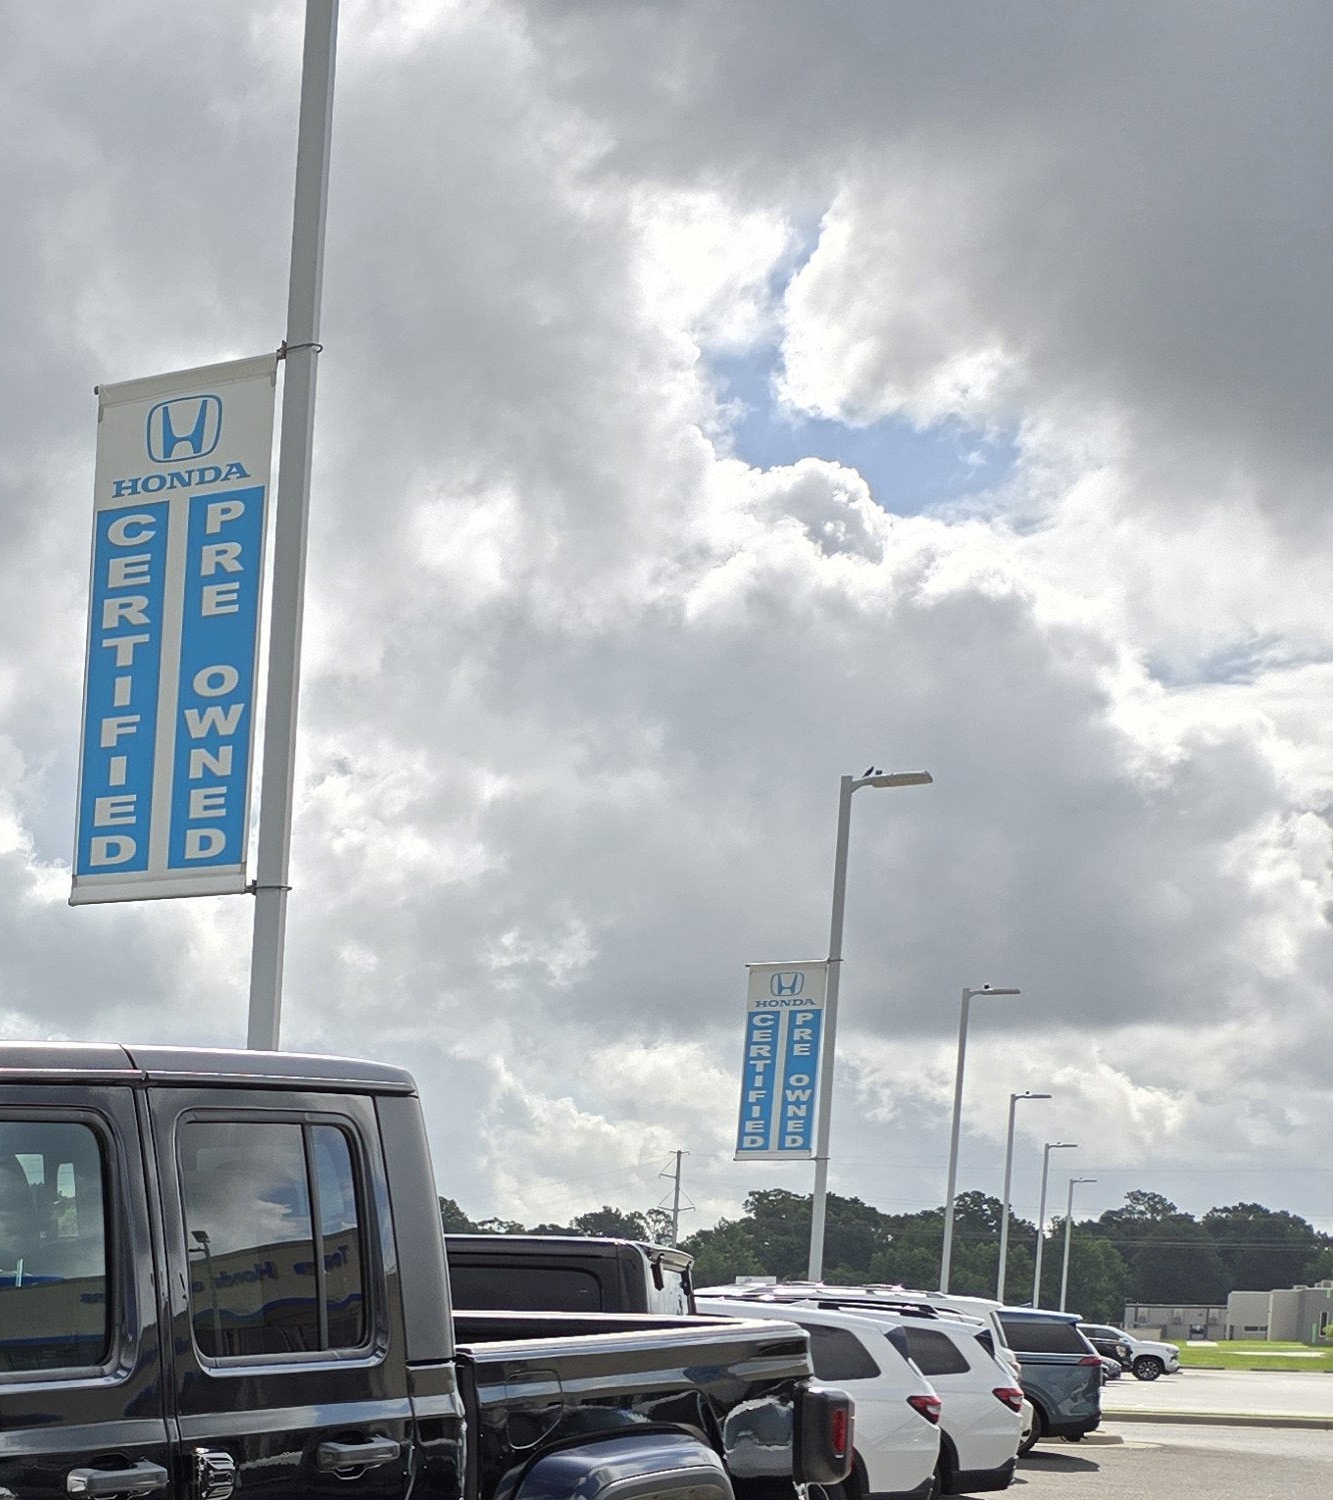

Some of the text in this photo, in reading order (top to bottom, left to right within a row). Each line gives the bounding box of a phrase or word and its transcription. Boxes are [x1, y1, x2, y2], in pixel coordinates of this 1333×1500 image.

[111, 462, 251, 498] HONDA
[89, 514, 157, 867] CERTIFIED
[184, 499, 246, 860] PRE OWNED
[754, 998, 816, 1009] HONDA
[742, 1013, 775, 1148] CERTIFIED
[784, 1012, 814, 1148] PRE OWNED
